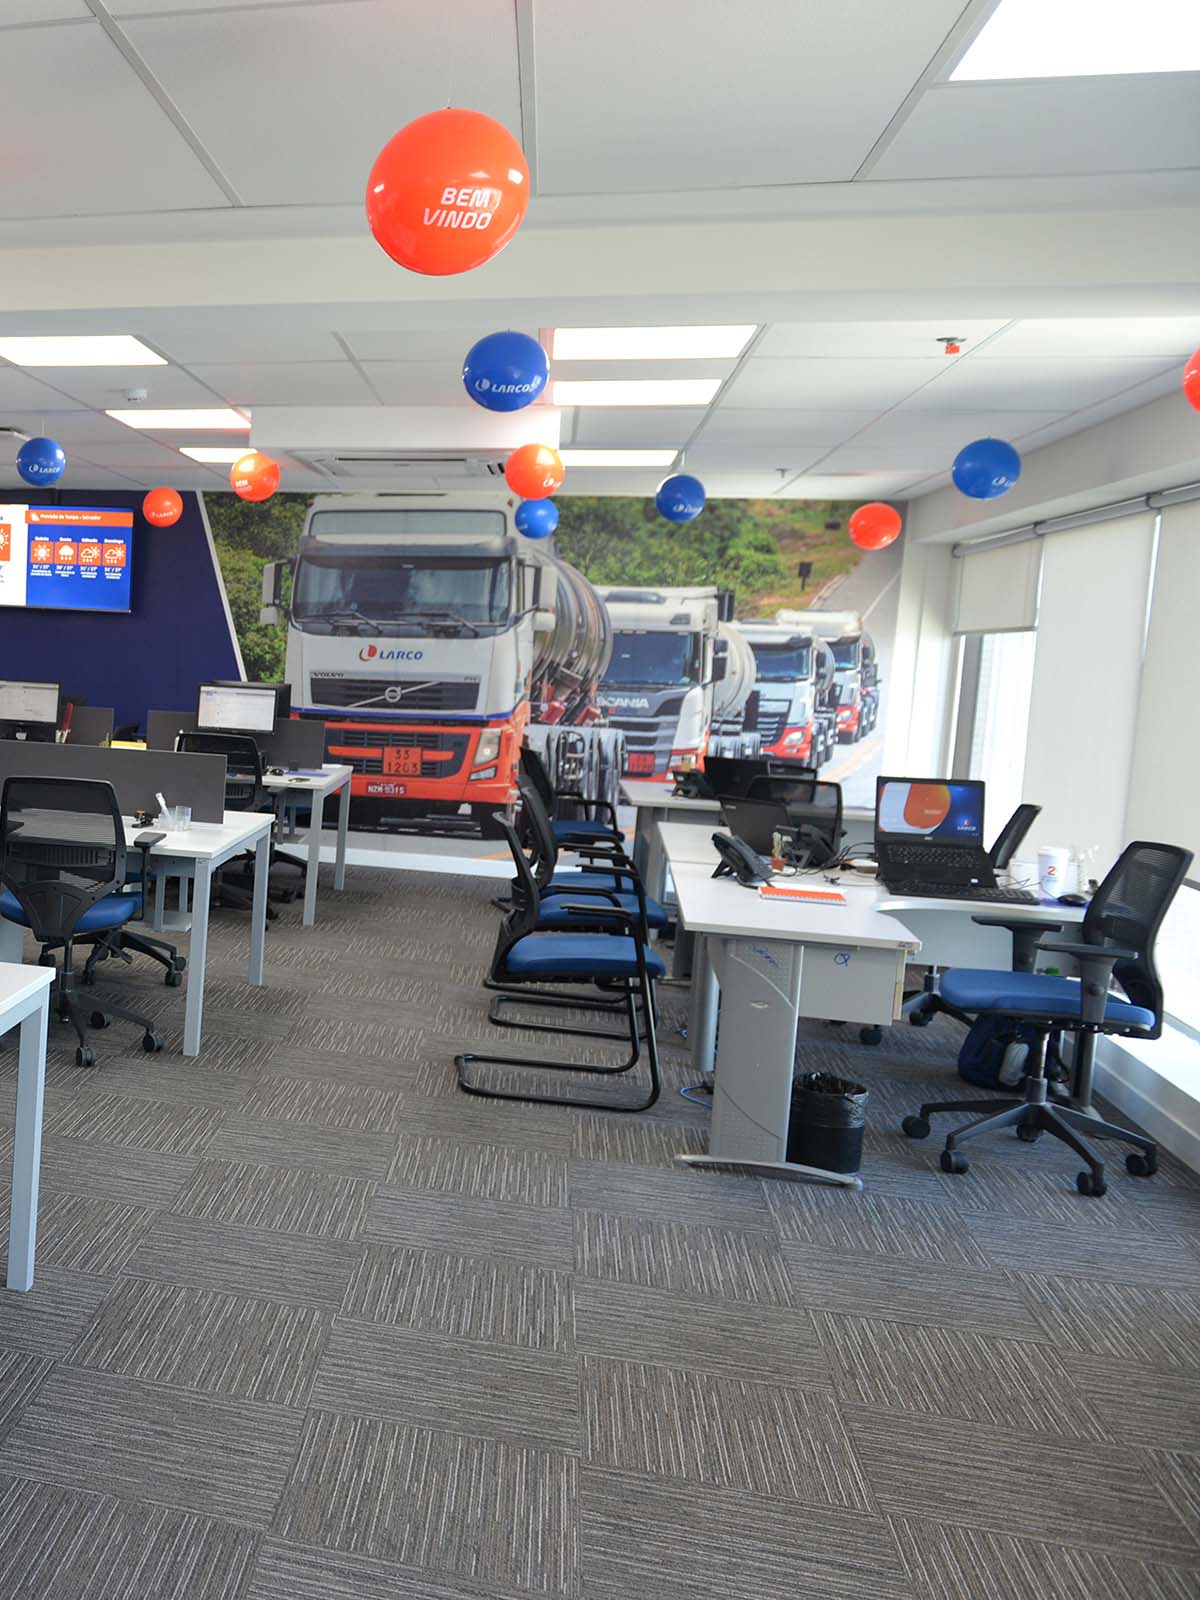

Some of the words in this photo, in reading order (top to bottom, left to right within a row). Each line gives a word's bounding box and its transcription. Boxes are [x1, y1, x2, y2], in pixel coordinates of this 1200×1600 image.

[441, 187, 491, 208] BEM
[423, 208, 492, 230] VINDO
[491, 383, 531, 394] LARCO
[39, 465, 61, 474] LARCO
[379, 650, 424, 661] LARCO
[387, 762, 418, 773] 1203
